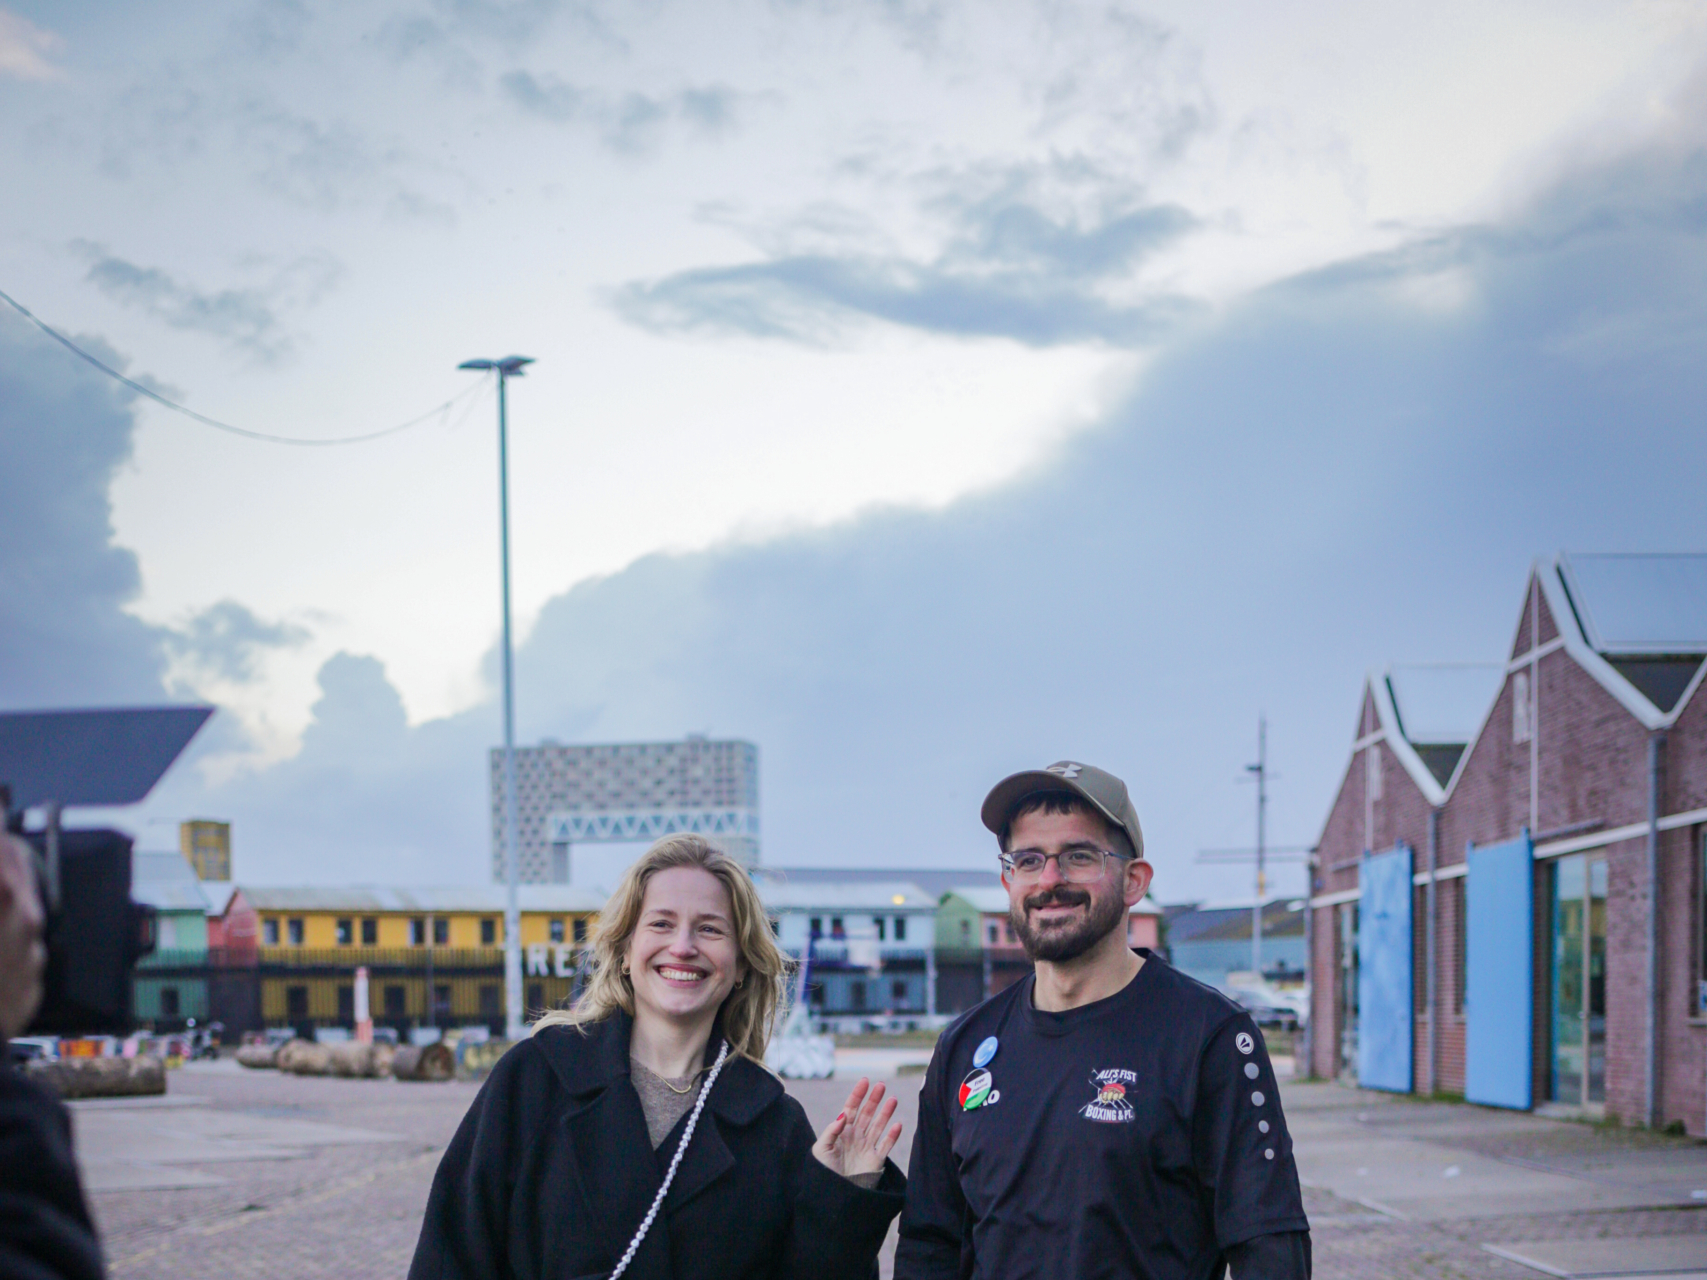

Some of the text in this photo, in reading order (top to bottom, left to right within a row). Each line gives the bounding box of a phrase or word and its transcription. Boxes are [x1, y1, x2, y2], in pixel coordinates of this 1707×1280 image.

[1096, 1068, 1137, 1082] ALI'S FIST
[1085, 1104, 1117, 1121] BOXING
[1117, 1109, 1124, 1121] &
